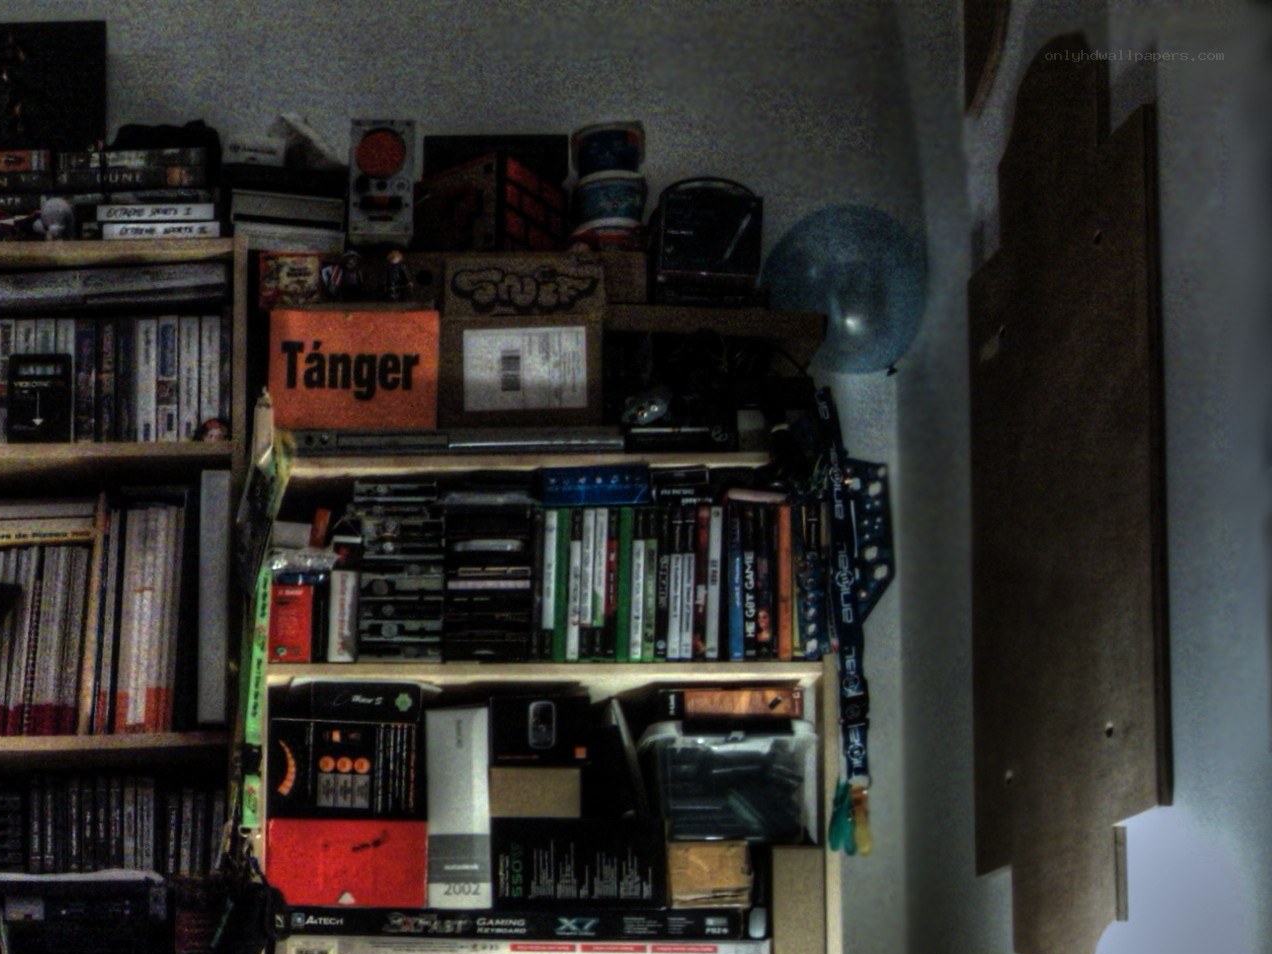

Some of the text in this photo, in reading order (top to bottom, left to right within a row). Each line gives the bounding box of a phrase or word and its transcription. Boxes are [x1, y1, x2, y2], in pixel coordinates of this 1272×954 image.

[280, 340, 420, 401] Tánger
[743, 550, 756, 638] HE GOT GAME
[443, 882, 481, 896] 2002
[476, 917, 526, 927] GAMING
[556, 917, 599, 932] X7
[476, 927, 527, 935] KEYBOARD
